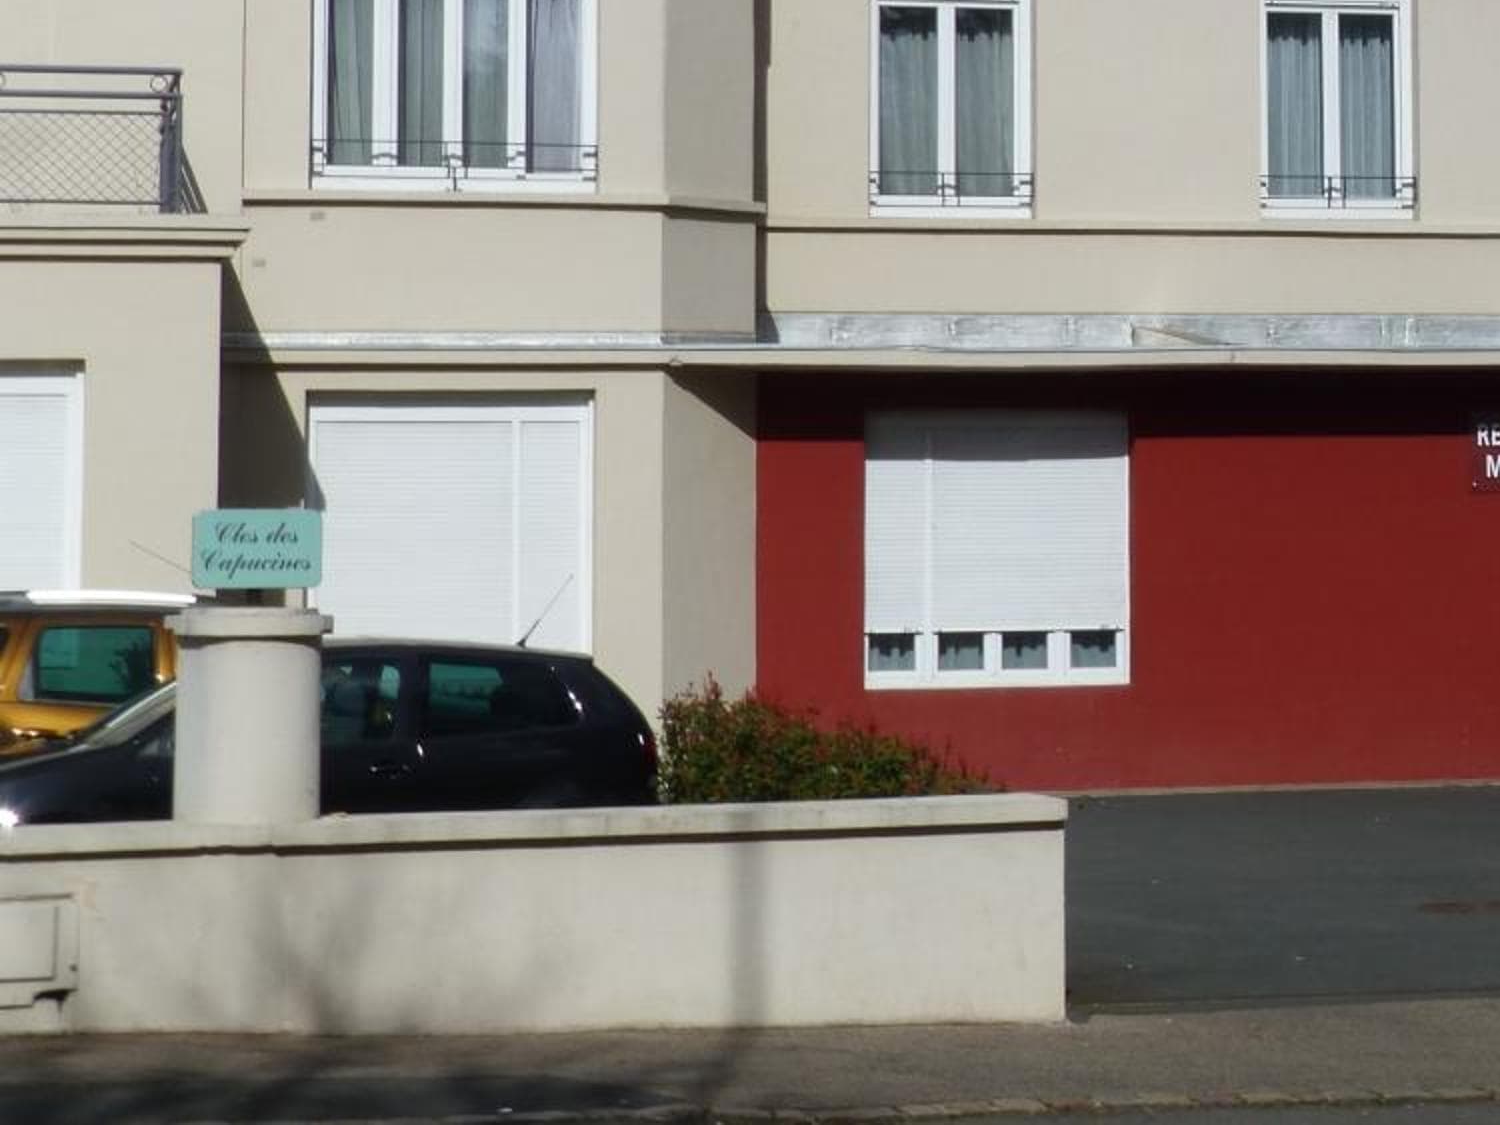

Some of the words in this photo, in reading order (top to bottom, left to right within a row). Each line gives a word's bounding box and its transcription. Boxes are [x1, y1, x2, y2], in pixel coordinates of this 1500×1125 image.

[214, 522, 258, 543] Clos
[265, 522, 299, 543] des
[201, 550, 311, 579] Capucines
